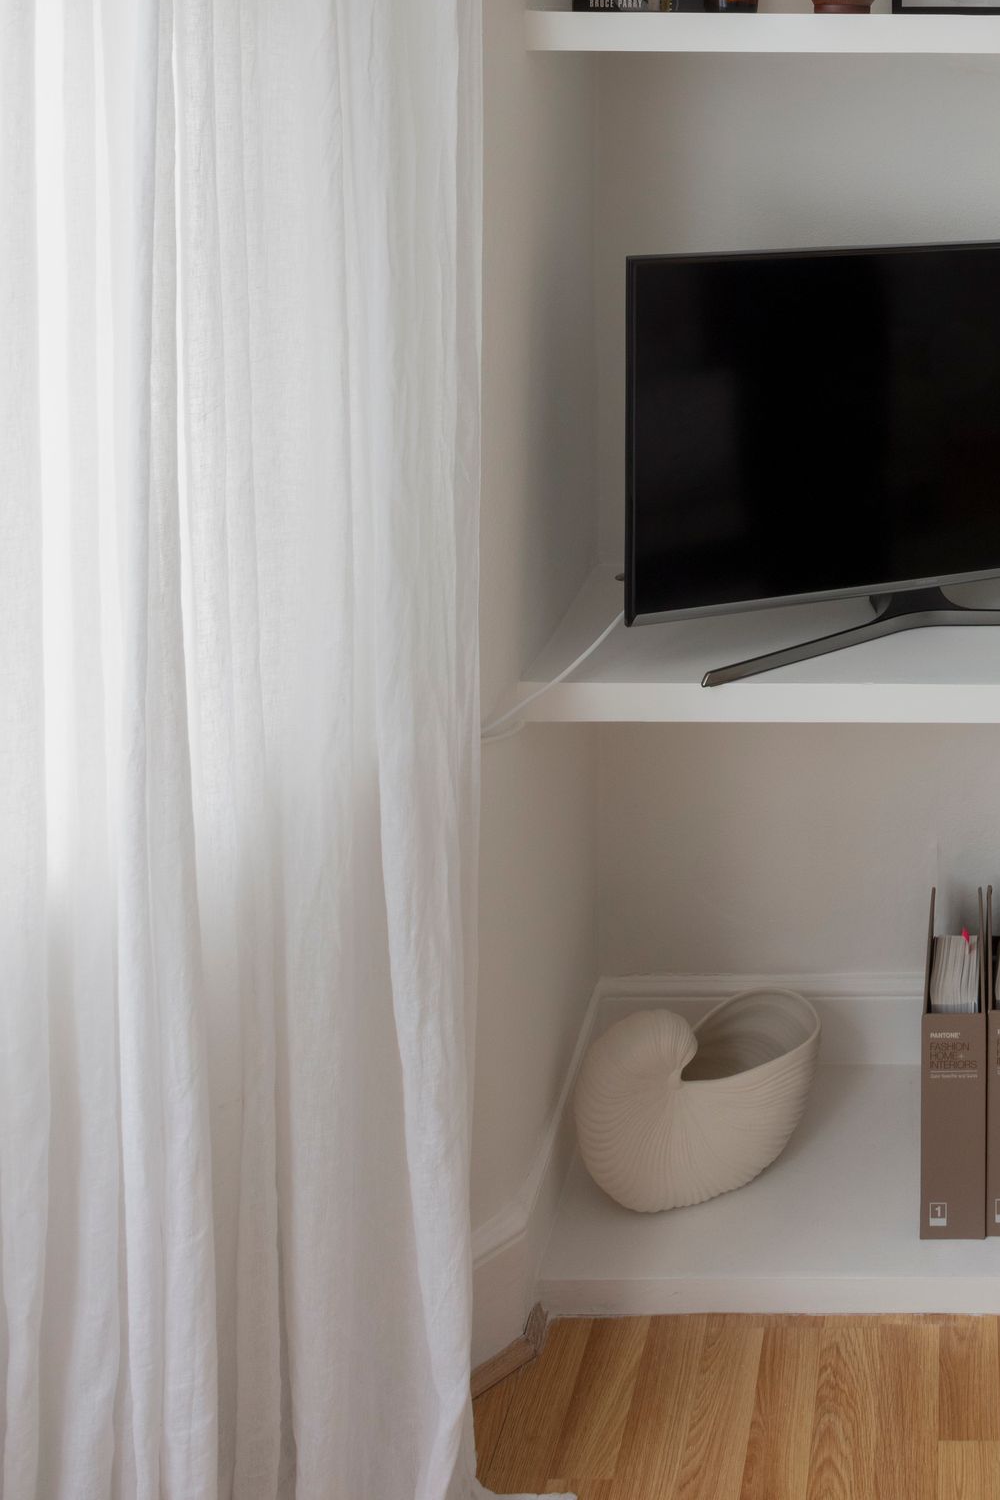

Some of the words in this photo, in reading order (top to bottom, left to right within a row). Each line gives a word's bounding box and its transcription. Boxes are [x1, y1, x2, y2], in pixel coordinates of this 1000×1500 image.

[590, 0, 614, 8] BRUCE
[618, 0, 643, 9] PARRY
[930, 1042, 970, 1051] FASHION
[930, 1051, 958, 1060] HOME
[930, 1060, 978, 1069] INTERIORS
[935, 1205, 943, 1217] 1
